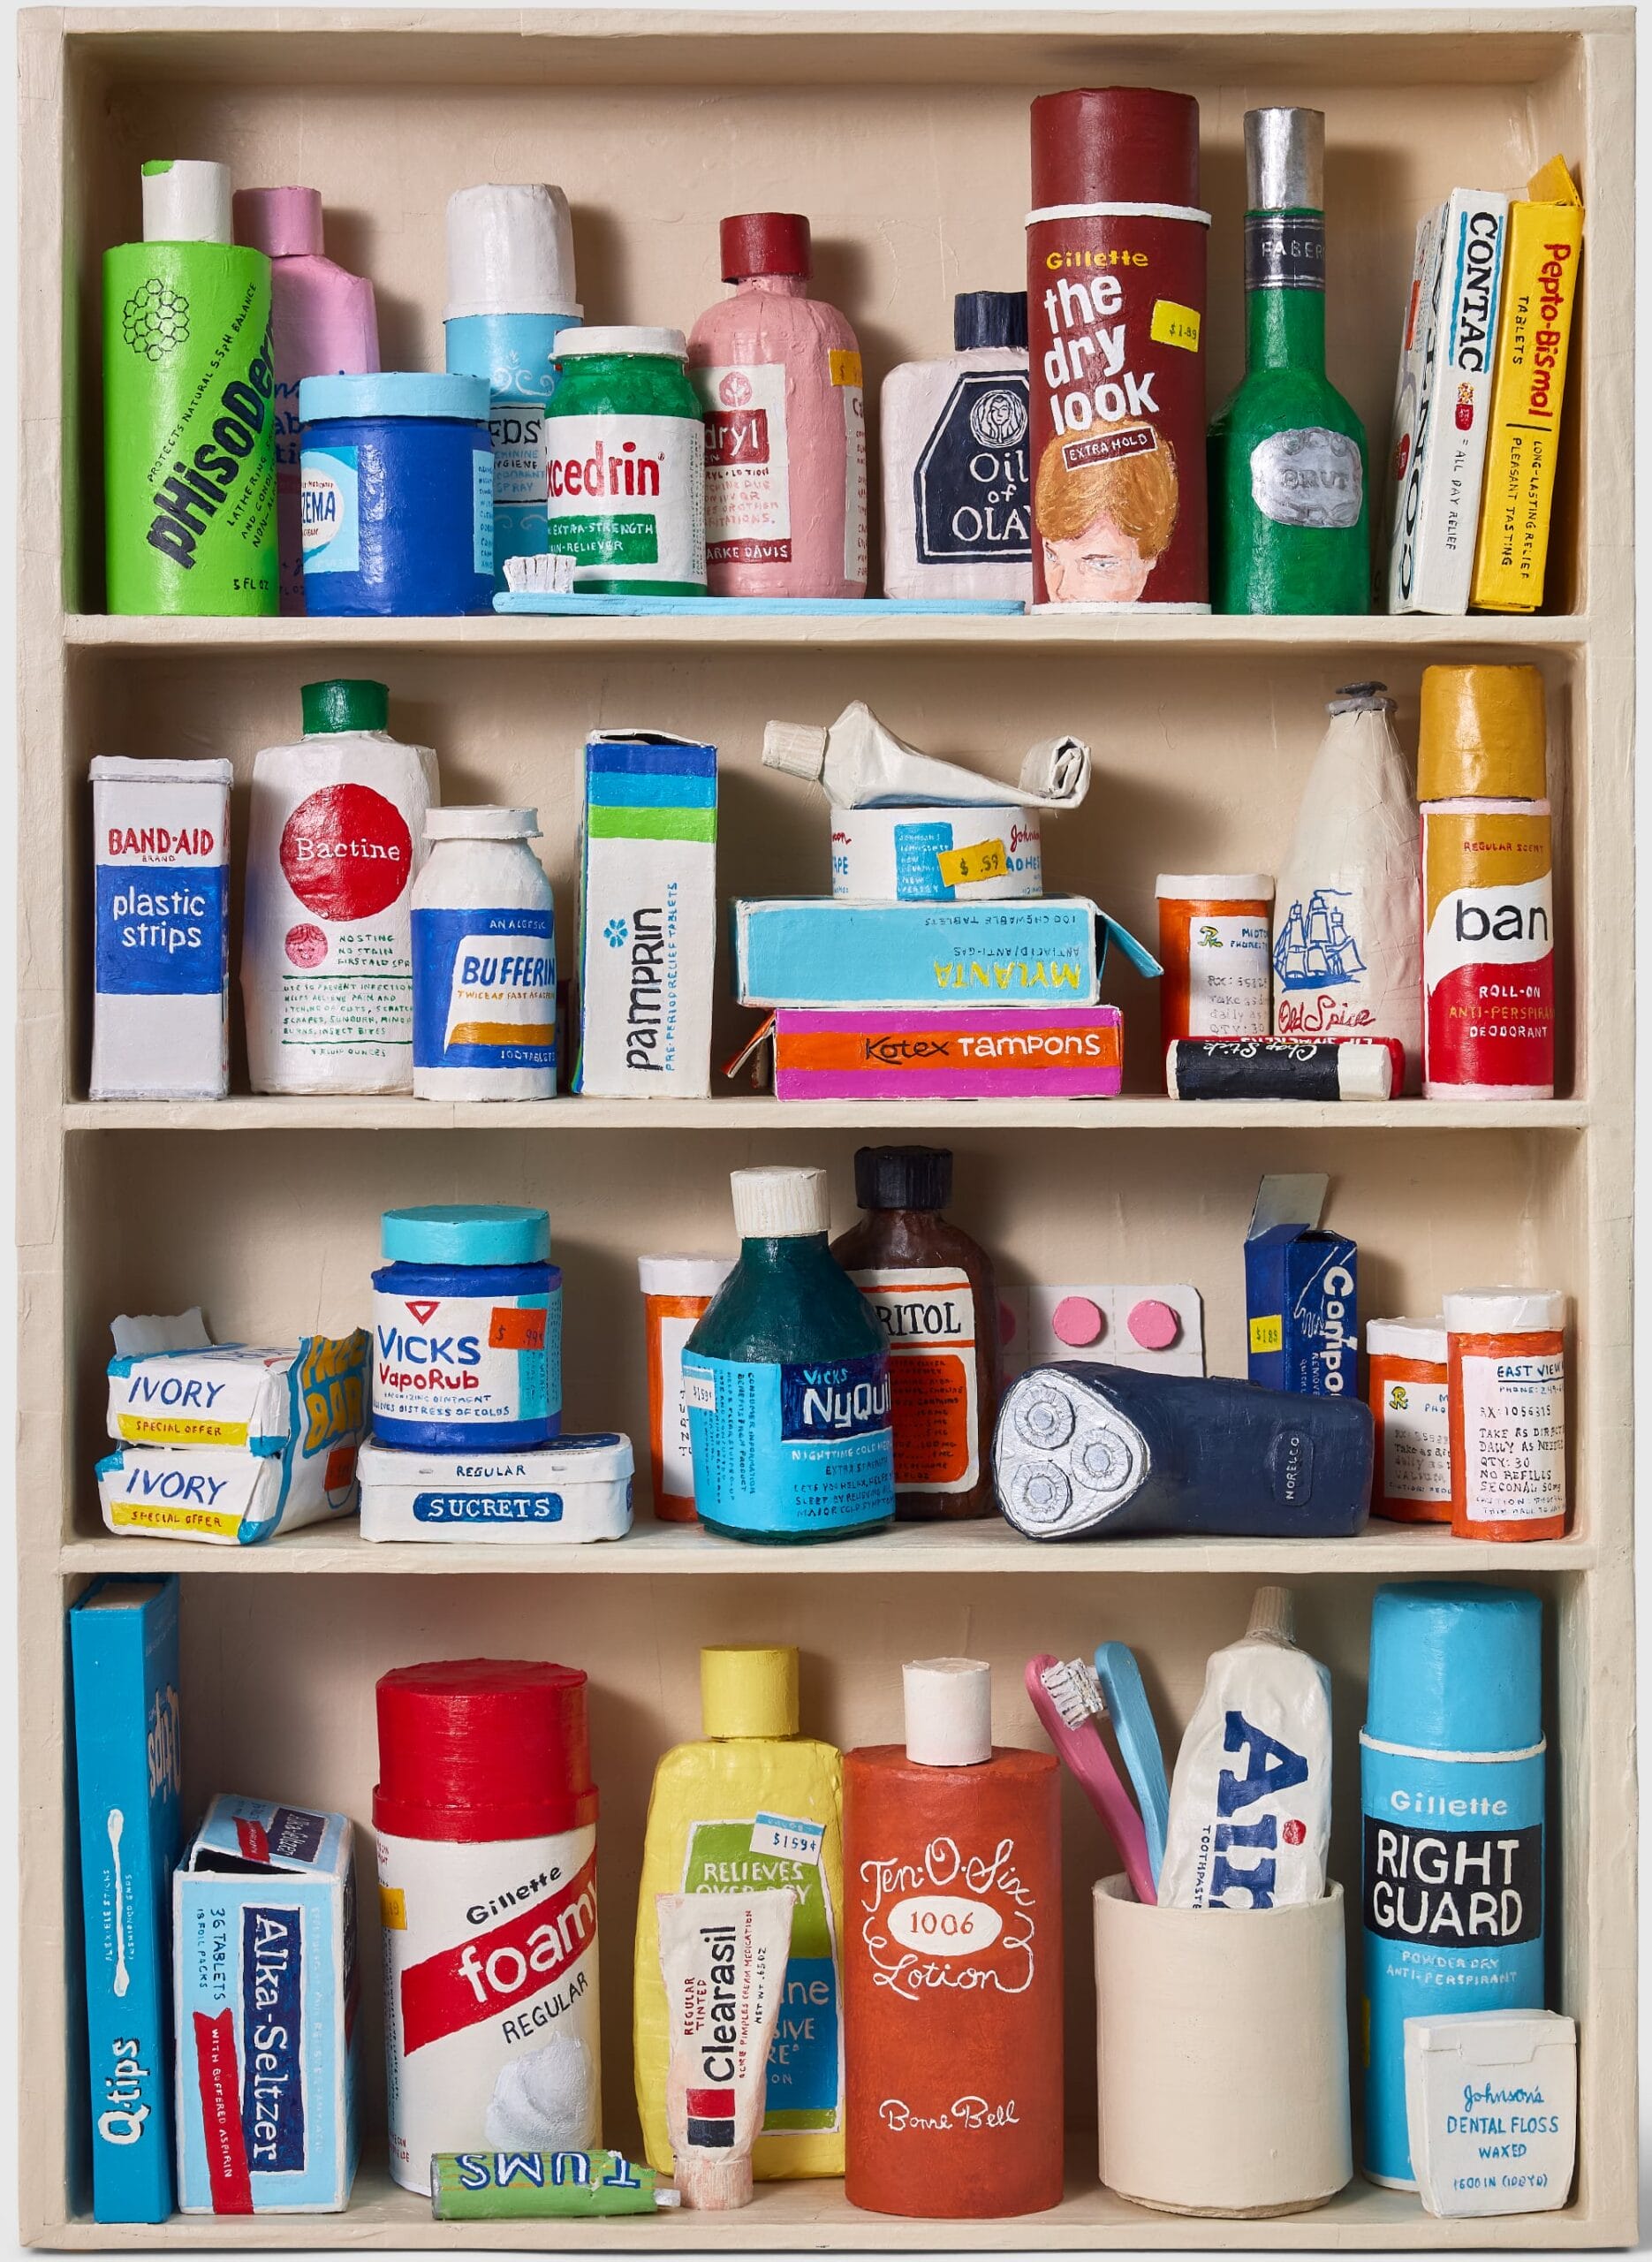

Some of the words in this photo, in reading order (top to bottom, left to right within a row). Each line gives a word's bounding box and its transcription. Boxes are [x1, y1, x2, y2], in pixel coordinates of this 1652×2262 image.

[1046, 250, 1148, 269] Gillette
[1043, 275, 1123, 334] the
[1458, 212, 1498, 373] CONTAC
[1513, 296, 1529, 365] TABLETS
[1528, 243, 1572, 418] Pepto-Bismol
[1043, 324, 1126, 388] dry
[147, 424, 185, 482] PROTECTS
[182, 372, 214, 422] NATURAL
[231, 282, 257, 332] BALANCE
[1050, 371, 1160, 436] look
[1069, 444, 1109, 461] EXTRA
[1110, 432, 1148, 450] HOLD
[1453, 450, 1466, 473] ALL
[969, 450, 1029, 482] Oil
[1507, 437, 1523, 501] PLEASANT
[226, 457, 268, 527] LATHERING
[988, 484, 1017, 504] of
[1449, 479, 1462, 506] DAY
[1525, 440, 1543, 530] LONG-LASTING
[240, 516, 257, 540] AND
[1445, 511, 1459, 550] RELIEF
[1501, 506, 1516, 566] TASTING
[1519, 532, 1535, 580] RELIEF
[233, 579, 241, 590] 5
[244, 577, 256, 590] FL
[296, 838, 401, 862] Bactine
[1464, 841, 1513, 853] REGULAR
[1516, 842, 1544, 854] SCENT
[113, 885, 207, 921] plastic
[489, 919, 547, 930] ANALGESIC
[924, 916, 980, 926] TABLETS
[984, 915, 1050, 925] CHEWABLE
[1054, 915, 1076, 925] 100
[1456, 899, 1549, 942] ban
[122, 921, 202, 954] strips
[461, 956, 556, 988] BUFFERIN
[667, 942, 678, 991] RELIEF
[934, 960, 1081, 990] MYLANTA
[1479, 983, 1541, 998] ROLL-ON
[1278, 999, 1305, 1035] Old
[1309, 994, 1377, 1033] Spice
[1469, 1025, 1549, 1038] DEODORANT
[866, 1037, 949, 1066] Kotex
[1203, 1041, 1258, 1059] Stick
[1265, 1042, 1319, 1062] Chap
[1320, 1265, 1358, 1394] Compo
[377, 1325, 481, 1366] VICKS
[379, 1362, 480, 1393] VapoRub
[803, 1368, 849, 1385] VICKS
[1497, 1365, 1533, 1378] EAST
[1536, 1363, 1560, 1378] VIEW
[128, 1376, 226, 1408] IVORY
[433, 1394, 492, 1404] OINTMENT
[803, 1371, 891, 1429] NyQuil
[1499, 1385, 1539, 1394] PHONE:
[135, 1420, 181, 1434] SPECIAL
[184, 1424, 223, 1437] OFFER
[1479, 1427, 1509, 1439] TAKE
[792, 1449, 854, 1461] NIGHTTIME
[855, 1445, 876, 1455] COLD
[1479, 1439, 1515, 1454] DAILY
[456, 1465, 527, 1477] REGULAR
[1285, 1436, 1300, 1500] NORELCO
[1480, 1457, 1511, 1469] QTY:
[1515, 1457, 1530, 1469] 30
[1480, 1469, 1502, 1480] NO
[1504, 1469, 1552, 1481] REFILLS
[125, 1467, 229, 1506] IVORY
[1480, 1481, 1537, 1494] SECONAL
[130, 1510, 181, 1523] SPECIAL
[185, 1513, 223, 1528] OFFER
[427, 1499, 551, 1520] SUCRETS
[1390, 1789, 1508, 1818] Gillette
[703, 1861, 805, 1884] RELIEVES
[1376, 1828, 1520, 1886] RIGHT
[466, 1865, 563, 1925] Gillette
[1373, 1880, 1523, 1937] GUARD
[210, 1908, 226, 1929] 36
[909, 1911, 974, 1936] 1006
[197, 1923, 207, 1947] FOIL
[744, 1909, 754, 1967] MEDICATION
[199, 1951, 208, 1989] PACKS
[213, 1933, 227, 2001] TABLETS
[1386, 1964, 1518, 1986] ANTI-PERSPIRANT
[1402, 1950, 1466, 1970] POWDER
[1470, 1958, 1500, 1970] DRY
[741, 1970, 751, 2003] CREAM
[869, 1953, 1025, 2001] Lotion
[502, 1971, 589, 2045] REGULAR
[684, 1977, 695, 2036] REGULAR
[696, 1978, 708, 2031] TINTED
[700, 1925, 737, 2083] Clearasil
[754, 2000, 763, 2024] NET
[253, 1912, 290, 2161] Alka-Seltzer
[739, 2002, 750, 2046] PIMPLES
[879, 2099, 954, 2131] Bonne
[951, 2095, 1020, 2129] Bell
[1463, 2082, 1545, 2114] Johnson's
[212, 2068, 226, 2125] BUFFERED
[219, 2129, 233, 2178] ASPIRIN
[1446, 2114, 1506, 2135] DENTAL
[1511, 2115, 1559, 2134] FLOSS
[1478, 2143, 1527, 2160] WAXED
[454, 2151, 641, 2191] TUMS
